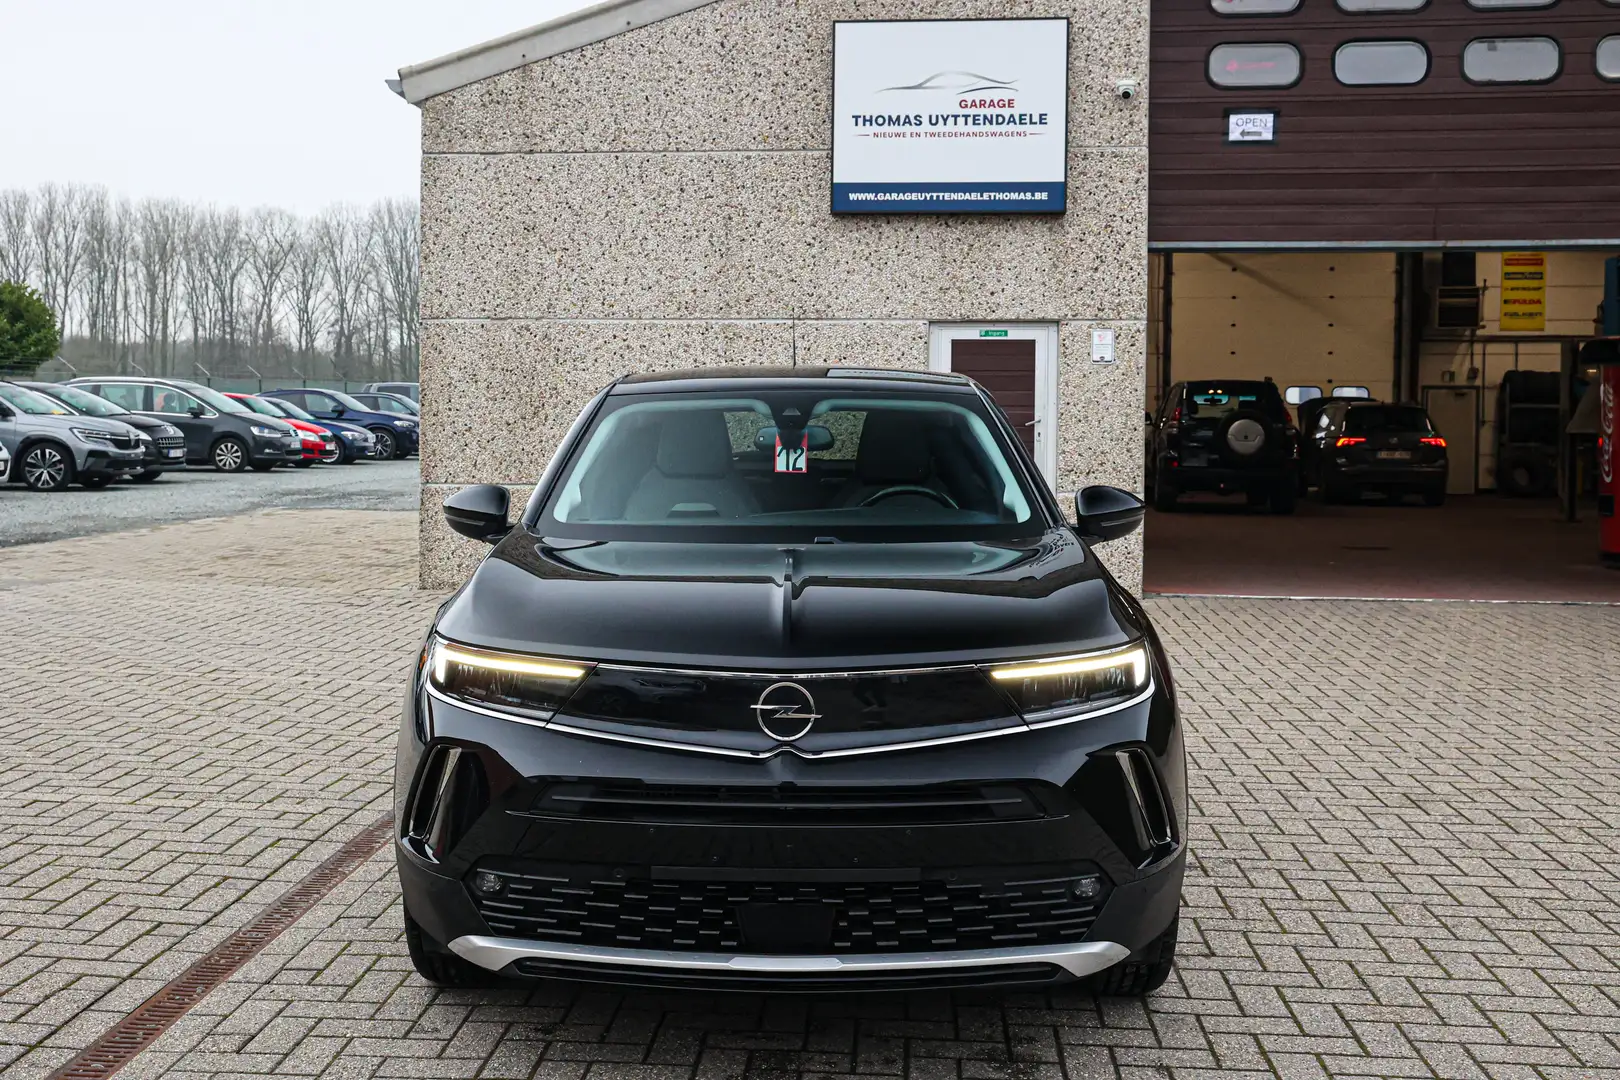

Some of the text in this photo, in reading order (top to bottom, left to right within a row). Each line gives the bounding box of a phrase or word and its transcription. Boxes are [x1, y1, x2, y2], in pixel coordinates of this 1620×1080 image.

[958, 98, 1015, 109] GARAGE
[851, 113, 1048, 127] THOMAS UYTTENDAELE
[1235, 117, 1268, 128] OPEN
[849, 191, 1048, 201] WWW.GARAGEUYTTENDAELETHOMAS.BE
[777, 445, 805, 472] 12
